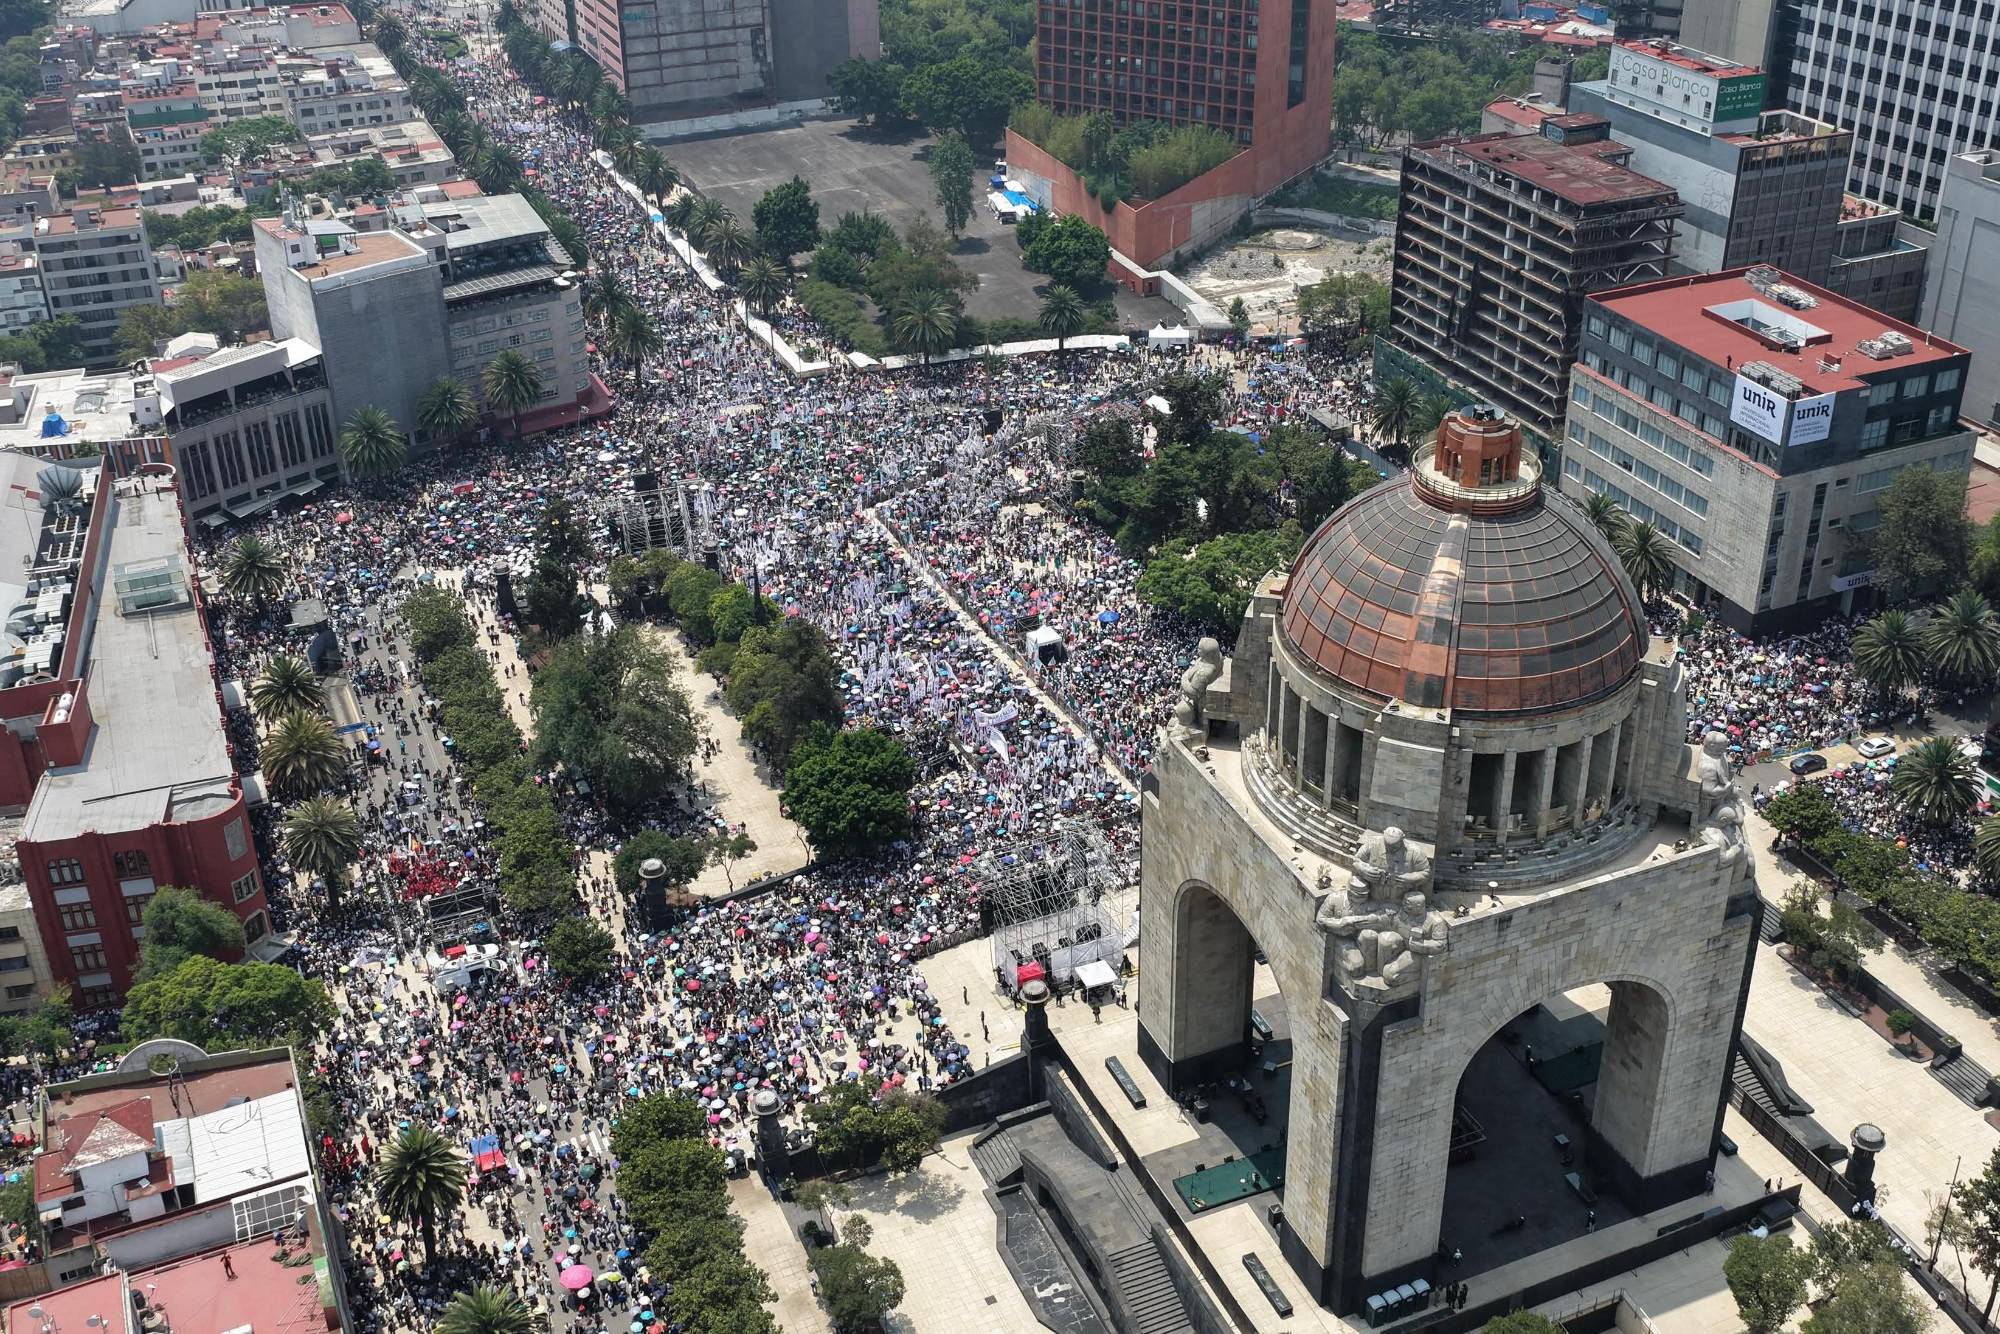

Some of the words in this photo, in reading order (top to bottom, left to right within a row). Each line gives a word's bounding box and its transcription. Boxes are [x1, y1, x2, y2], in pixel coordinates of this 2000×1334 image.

[1621, 55, 1657, 80] Casa
[1660, 67, 1710, 98] Blanca
[1719, 85, 1738, 94] Casa
[1738, 82, 1761, 91] Blanca
